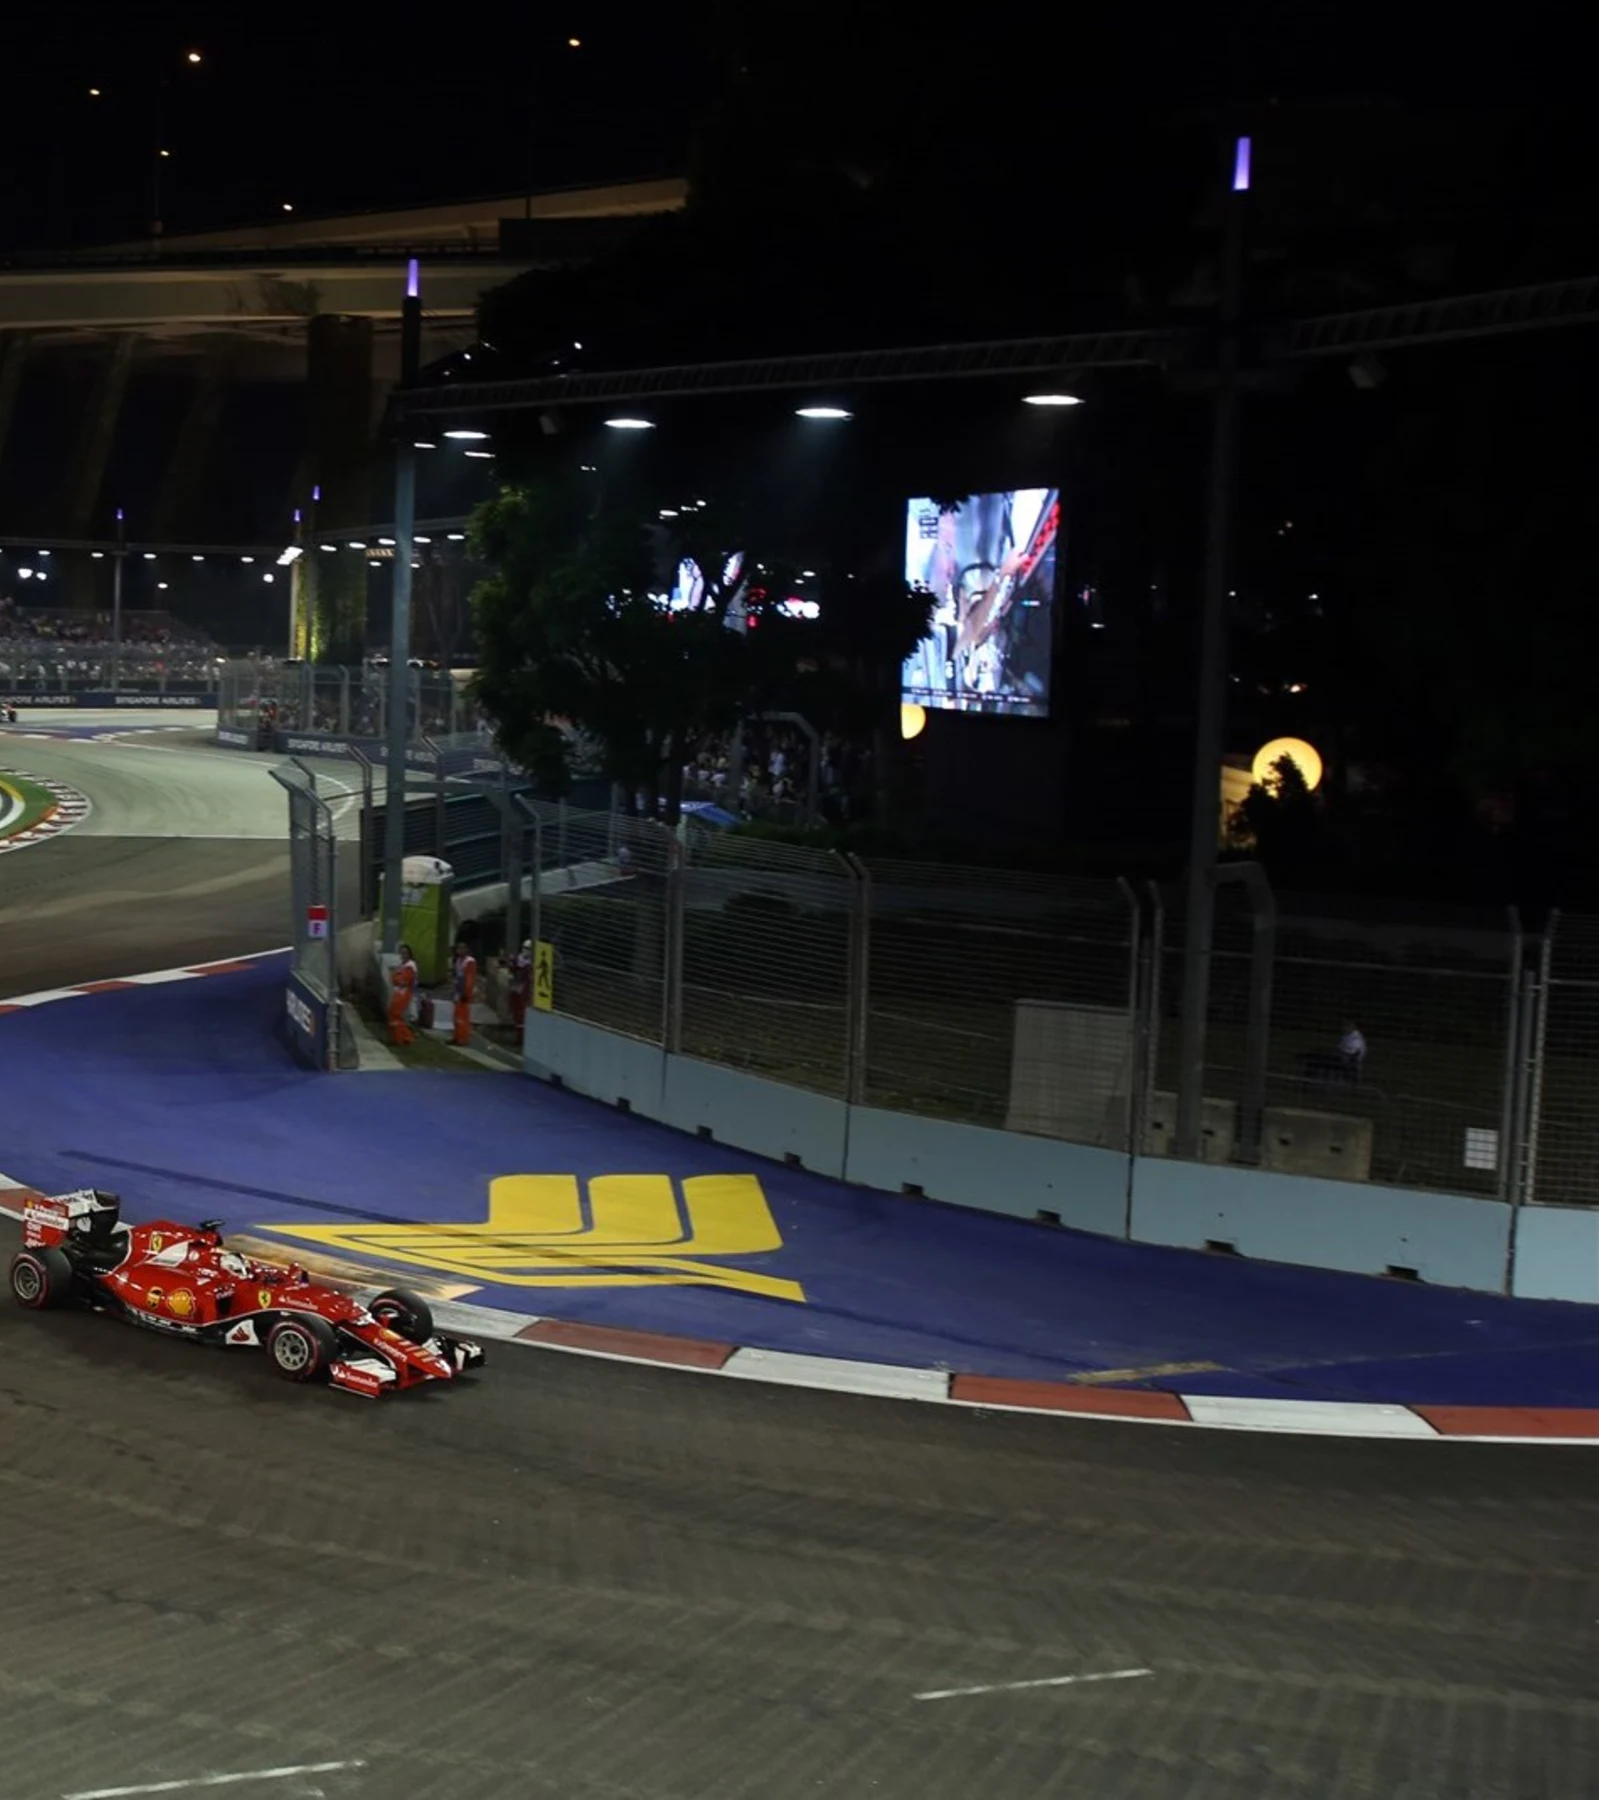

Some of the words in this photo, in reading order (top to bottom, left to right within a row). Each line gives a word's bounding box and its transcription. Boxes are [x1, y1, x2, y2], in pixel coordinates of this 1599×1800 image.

[34, 695, 71, 705] AIRLINES
[115, 696, 160, 705] SINGAPORE
[162, 696, 196, 705] AIRLINES
[346, 1371, 378, 1388] Santander
